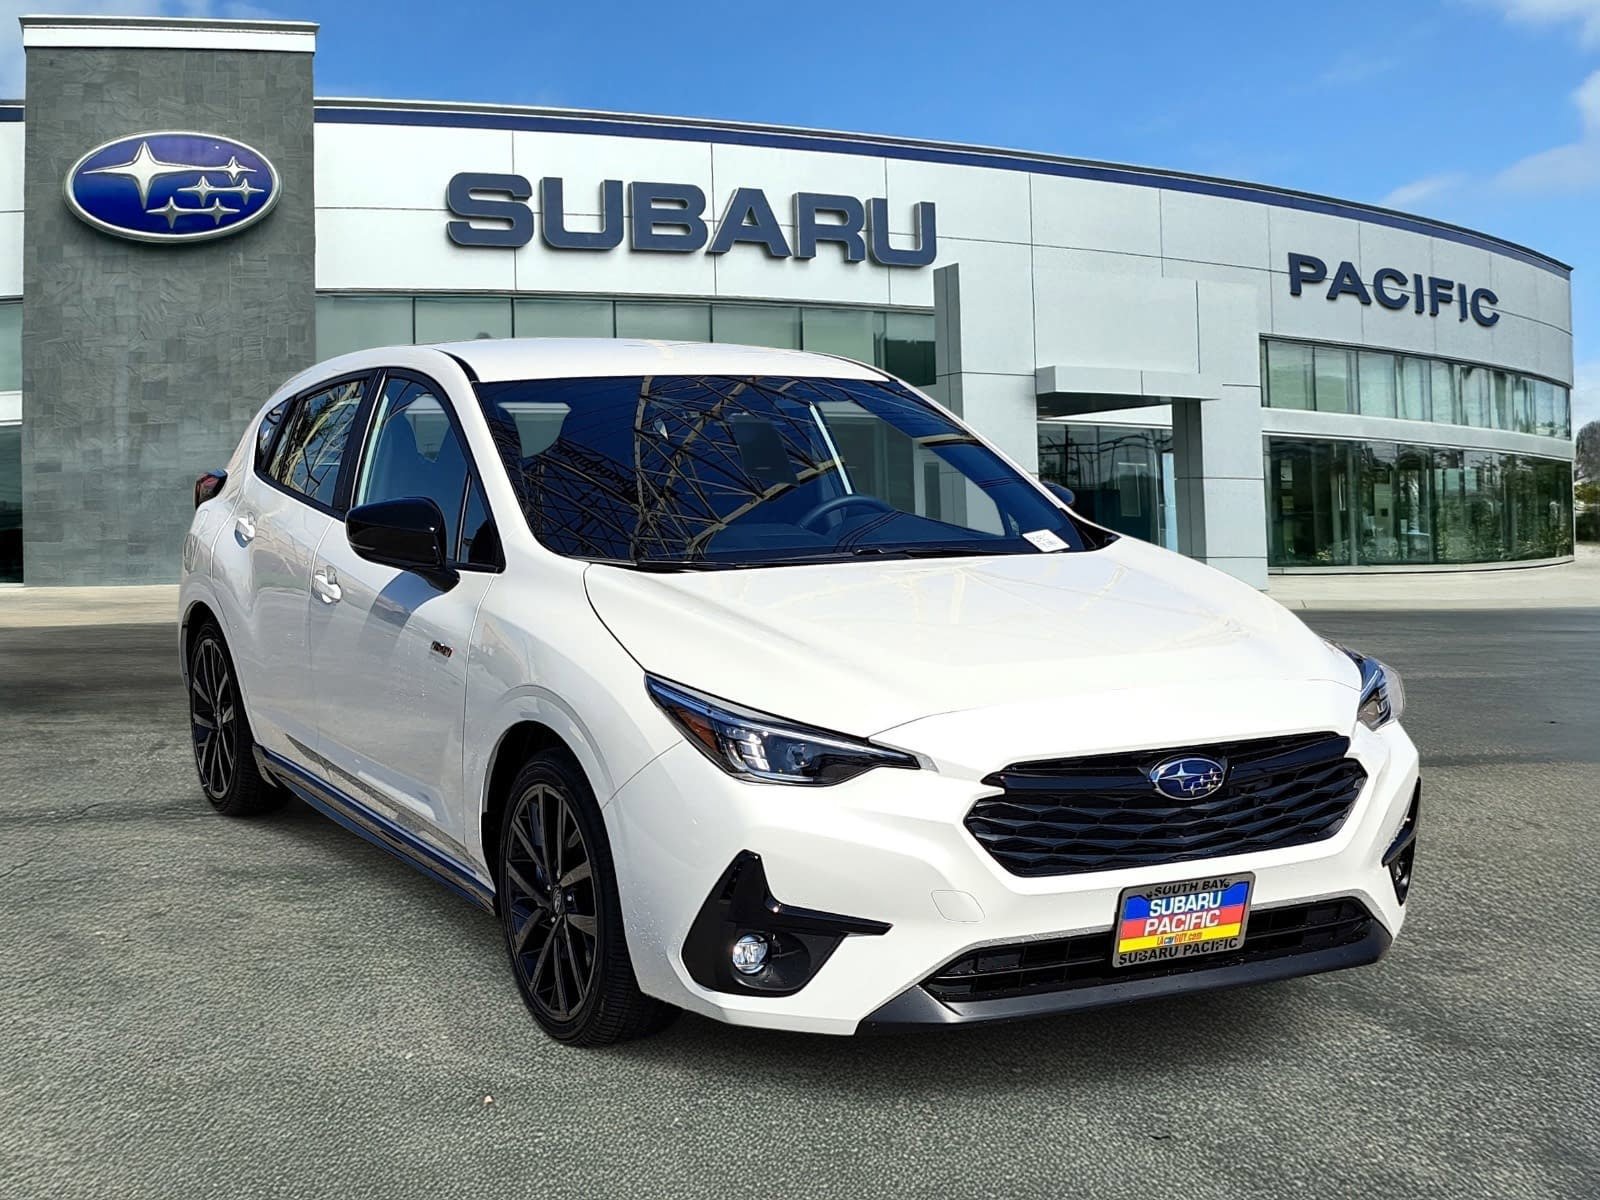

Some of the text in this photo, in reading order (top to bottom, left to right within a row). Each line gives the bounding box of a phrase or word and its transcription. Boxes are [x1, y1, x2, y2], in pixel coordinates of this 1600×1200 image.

[446, 171, 937, 267] SUBARU
[1287, 252, 1500, 327] PACIFIC
[1154, 878, 1226, 897] SOUTH BAY
[1149, 890, 1222, 917] SUBARU
[1144, 909, 1220, 936] PACIFIC
[1119, 938, 1238, 965] SUBARU PACIFIC
